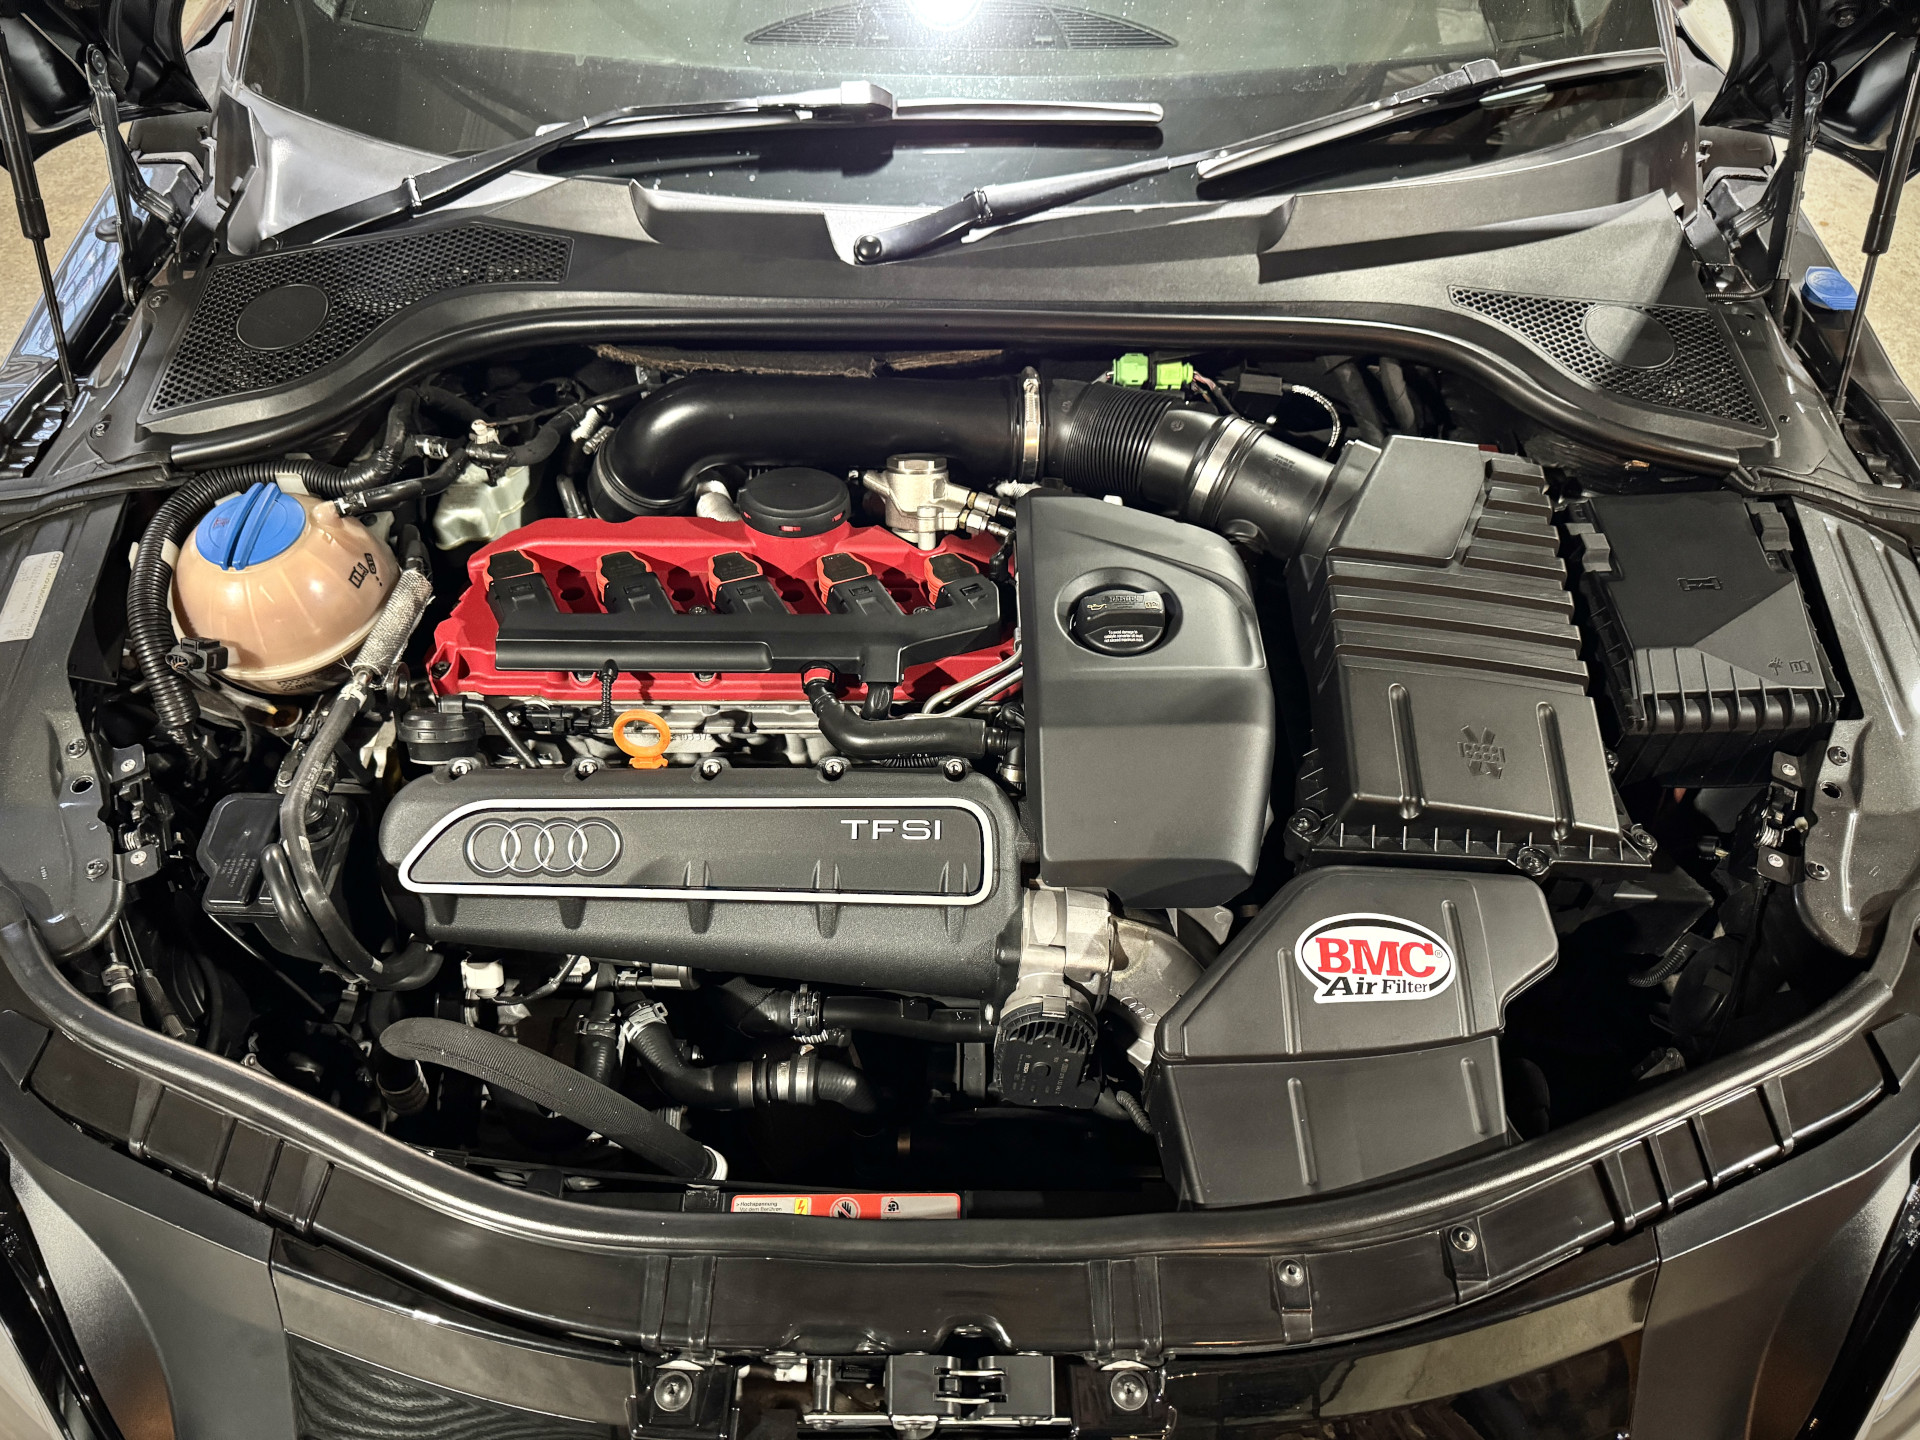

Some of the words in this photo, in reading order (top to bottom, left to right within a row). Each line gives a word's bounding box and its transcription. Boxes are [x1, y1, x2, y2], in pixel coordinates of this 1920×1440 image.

[840, 819, 942, 840] TFSI
[1315, 937, 1437, 978] BMC
[1321, 976, 1378, 997] Air
[1381, 979, 1428, 994] Filter
